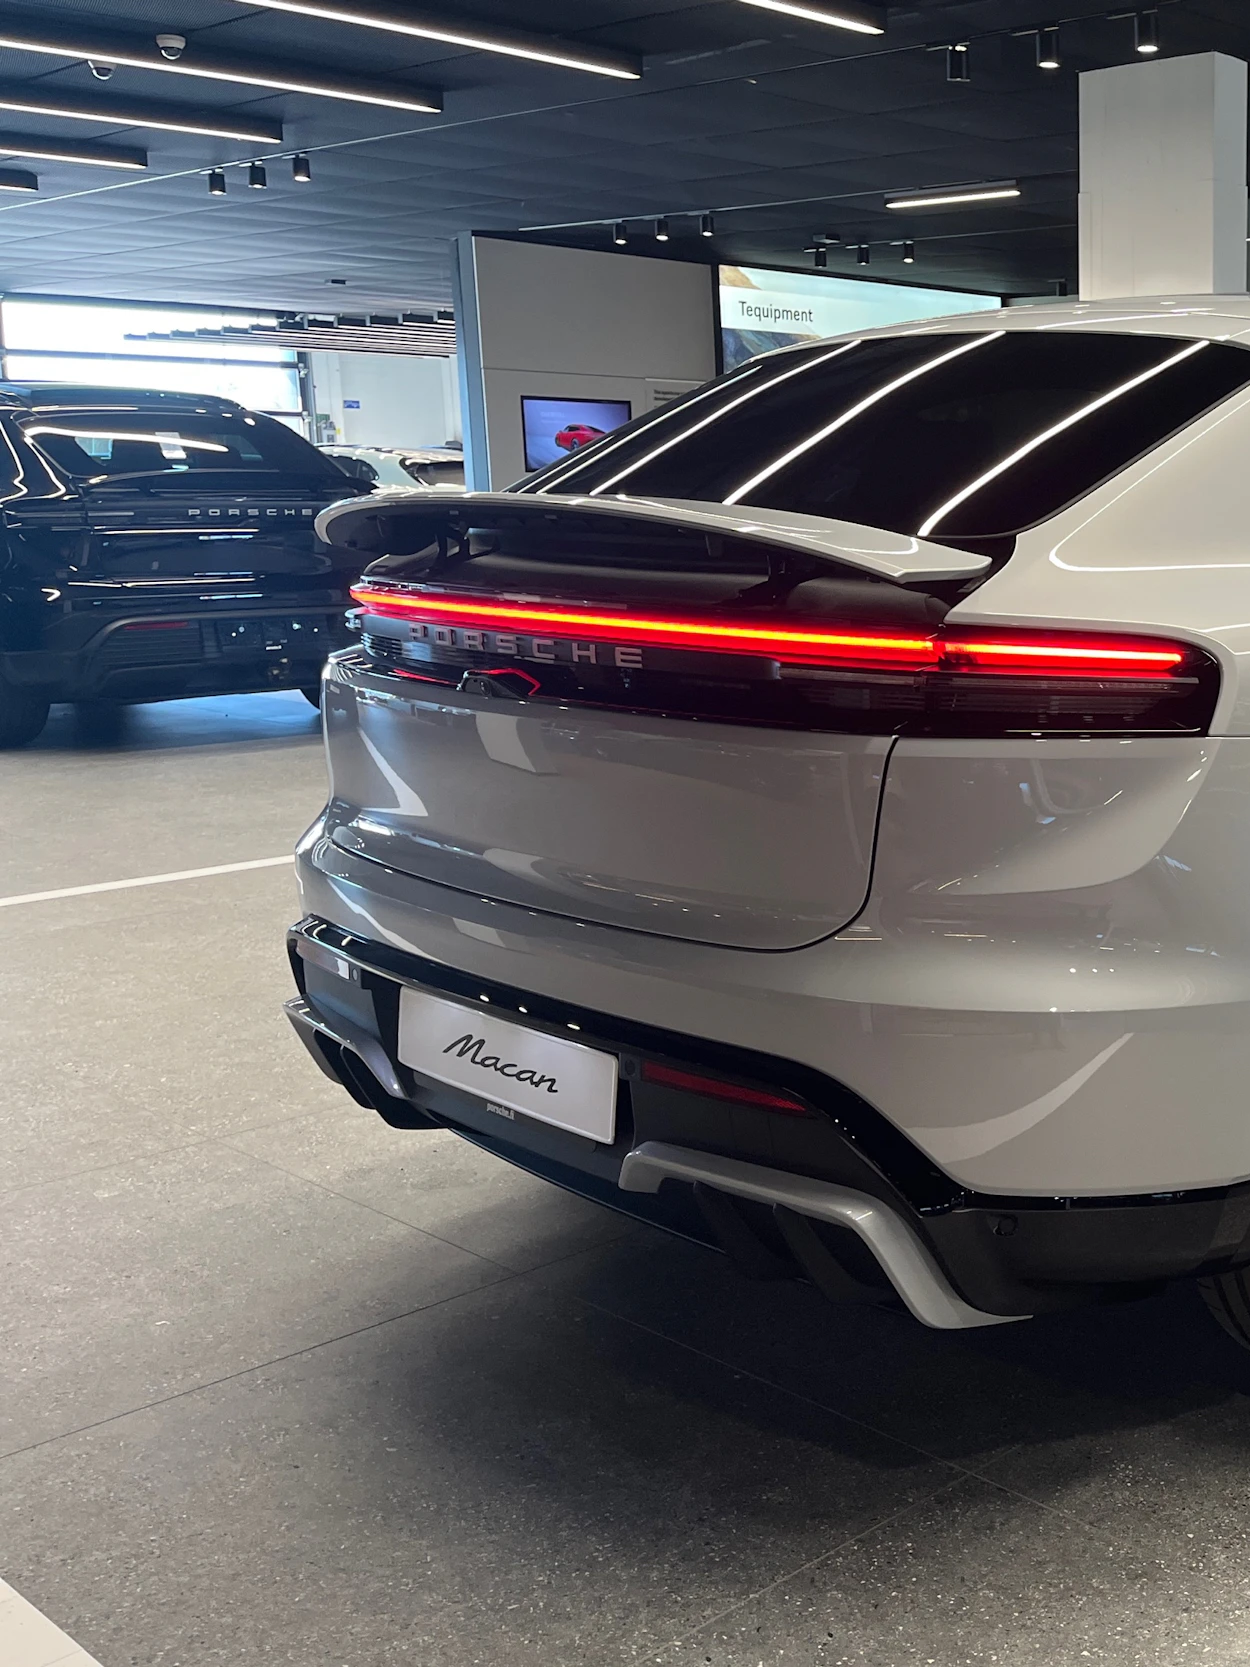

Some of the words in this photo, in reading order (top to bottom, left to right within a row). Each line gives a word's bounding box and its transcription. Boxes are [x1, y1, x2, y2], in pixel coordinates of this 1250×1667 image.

[738, 300, 814, 323] Tequipment
[188, 508, 313, 517] PORSCHE
[408, 623, 644, 669] PORSCHE
[441, 1034, 559, 1093] Macan
[486, 1102, 515, 1120] porsche.fi
